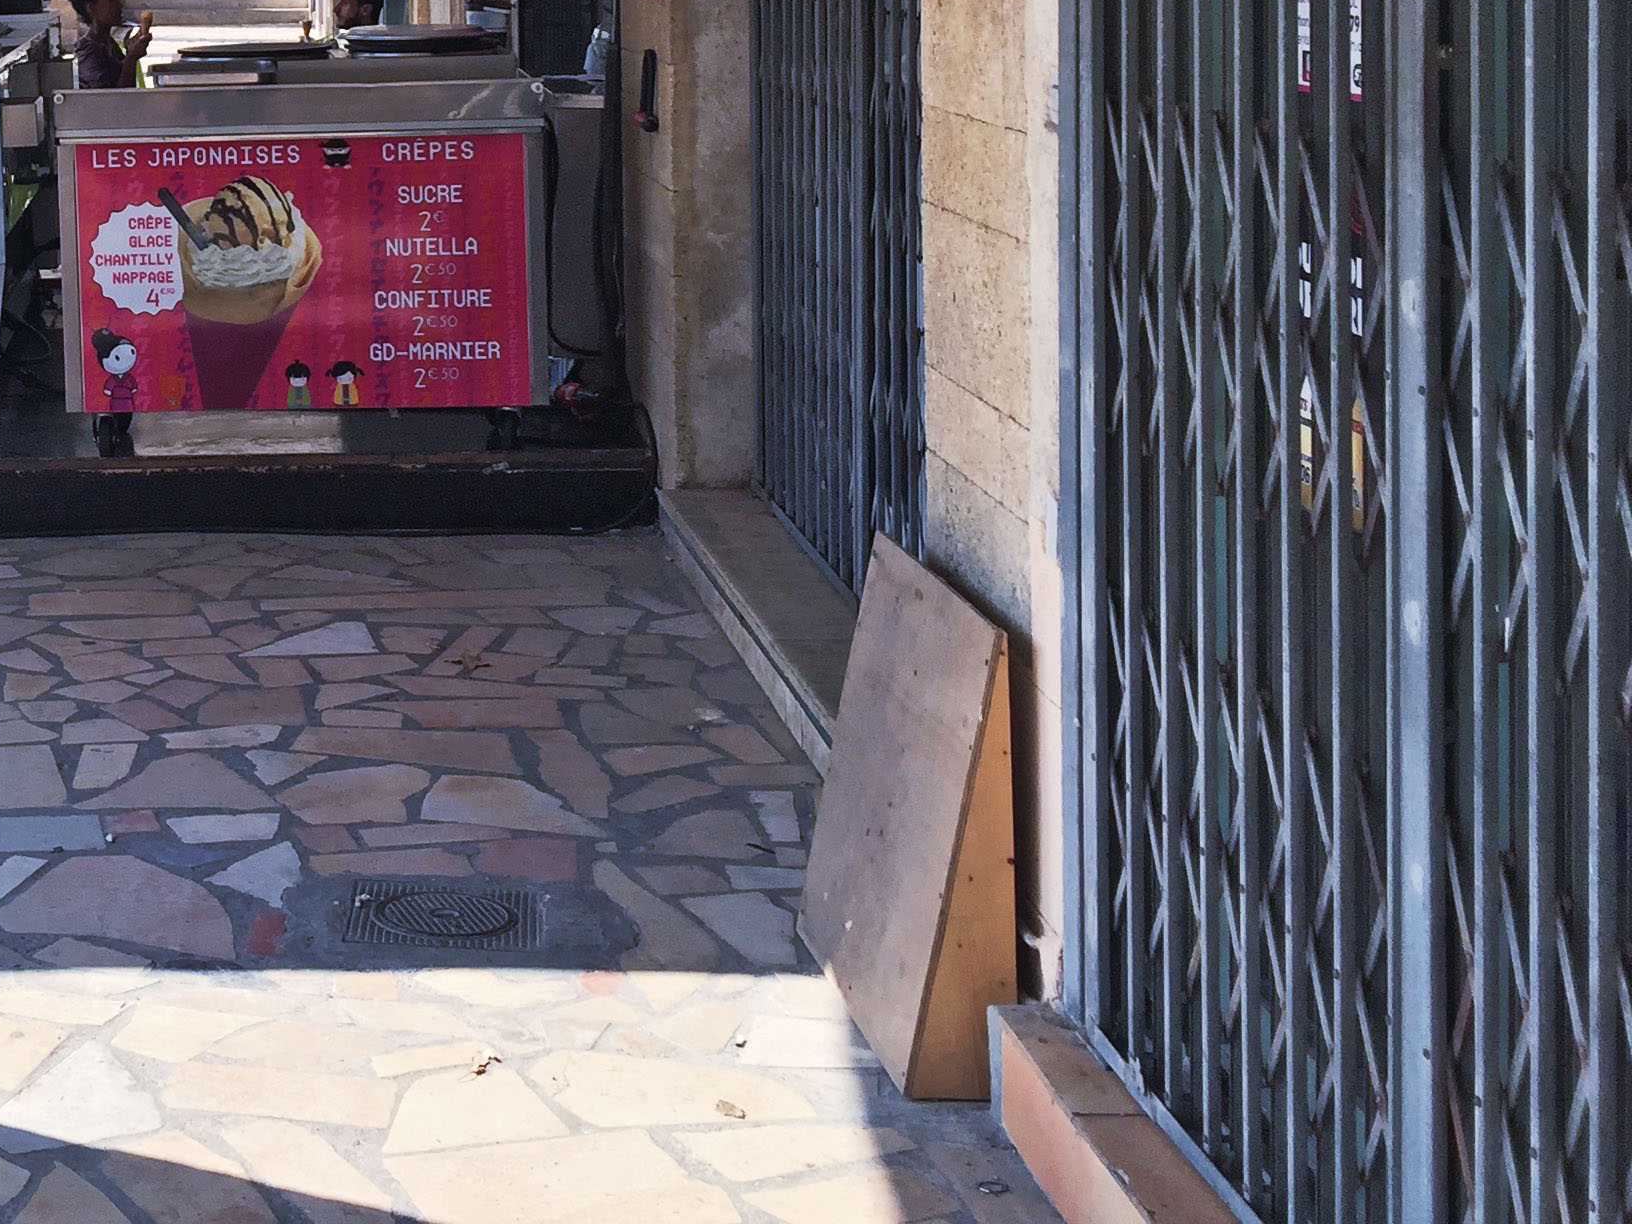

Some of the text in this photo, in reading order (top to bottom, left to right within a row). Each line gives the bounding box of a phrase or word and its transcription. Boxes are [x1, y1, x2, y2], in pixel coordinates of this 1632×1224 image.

[91, 145, 301, 169] LES JAPONAISES
[381, 138, 475, 162] CRÊPES
[398, 184, 463, 204] SUCRE
[127, 214, 173, 230] CRÊPE
[128, 234, 174, 249] GLACE
[385, 236, 479, 257] NUTELLA
[94, 253, 174, 268] CHANTILLY
[112, 271, 175, 285] NAPPAGE
[374, 289, 493, 309] CONFITURE
[369, 341, 501, 362] GD-MARNIER
